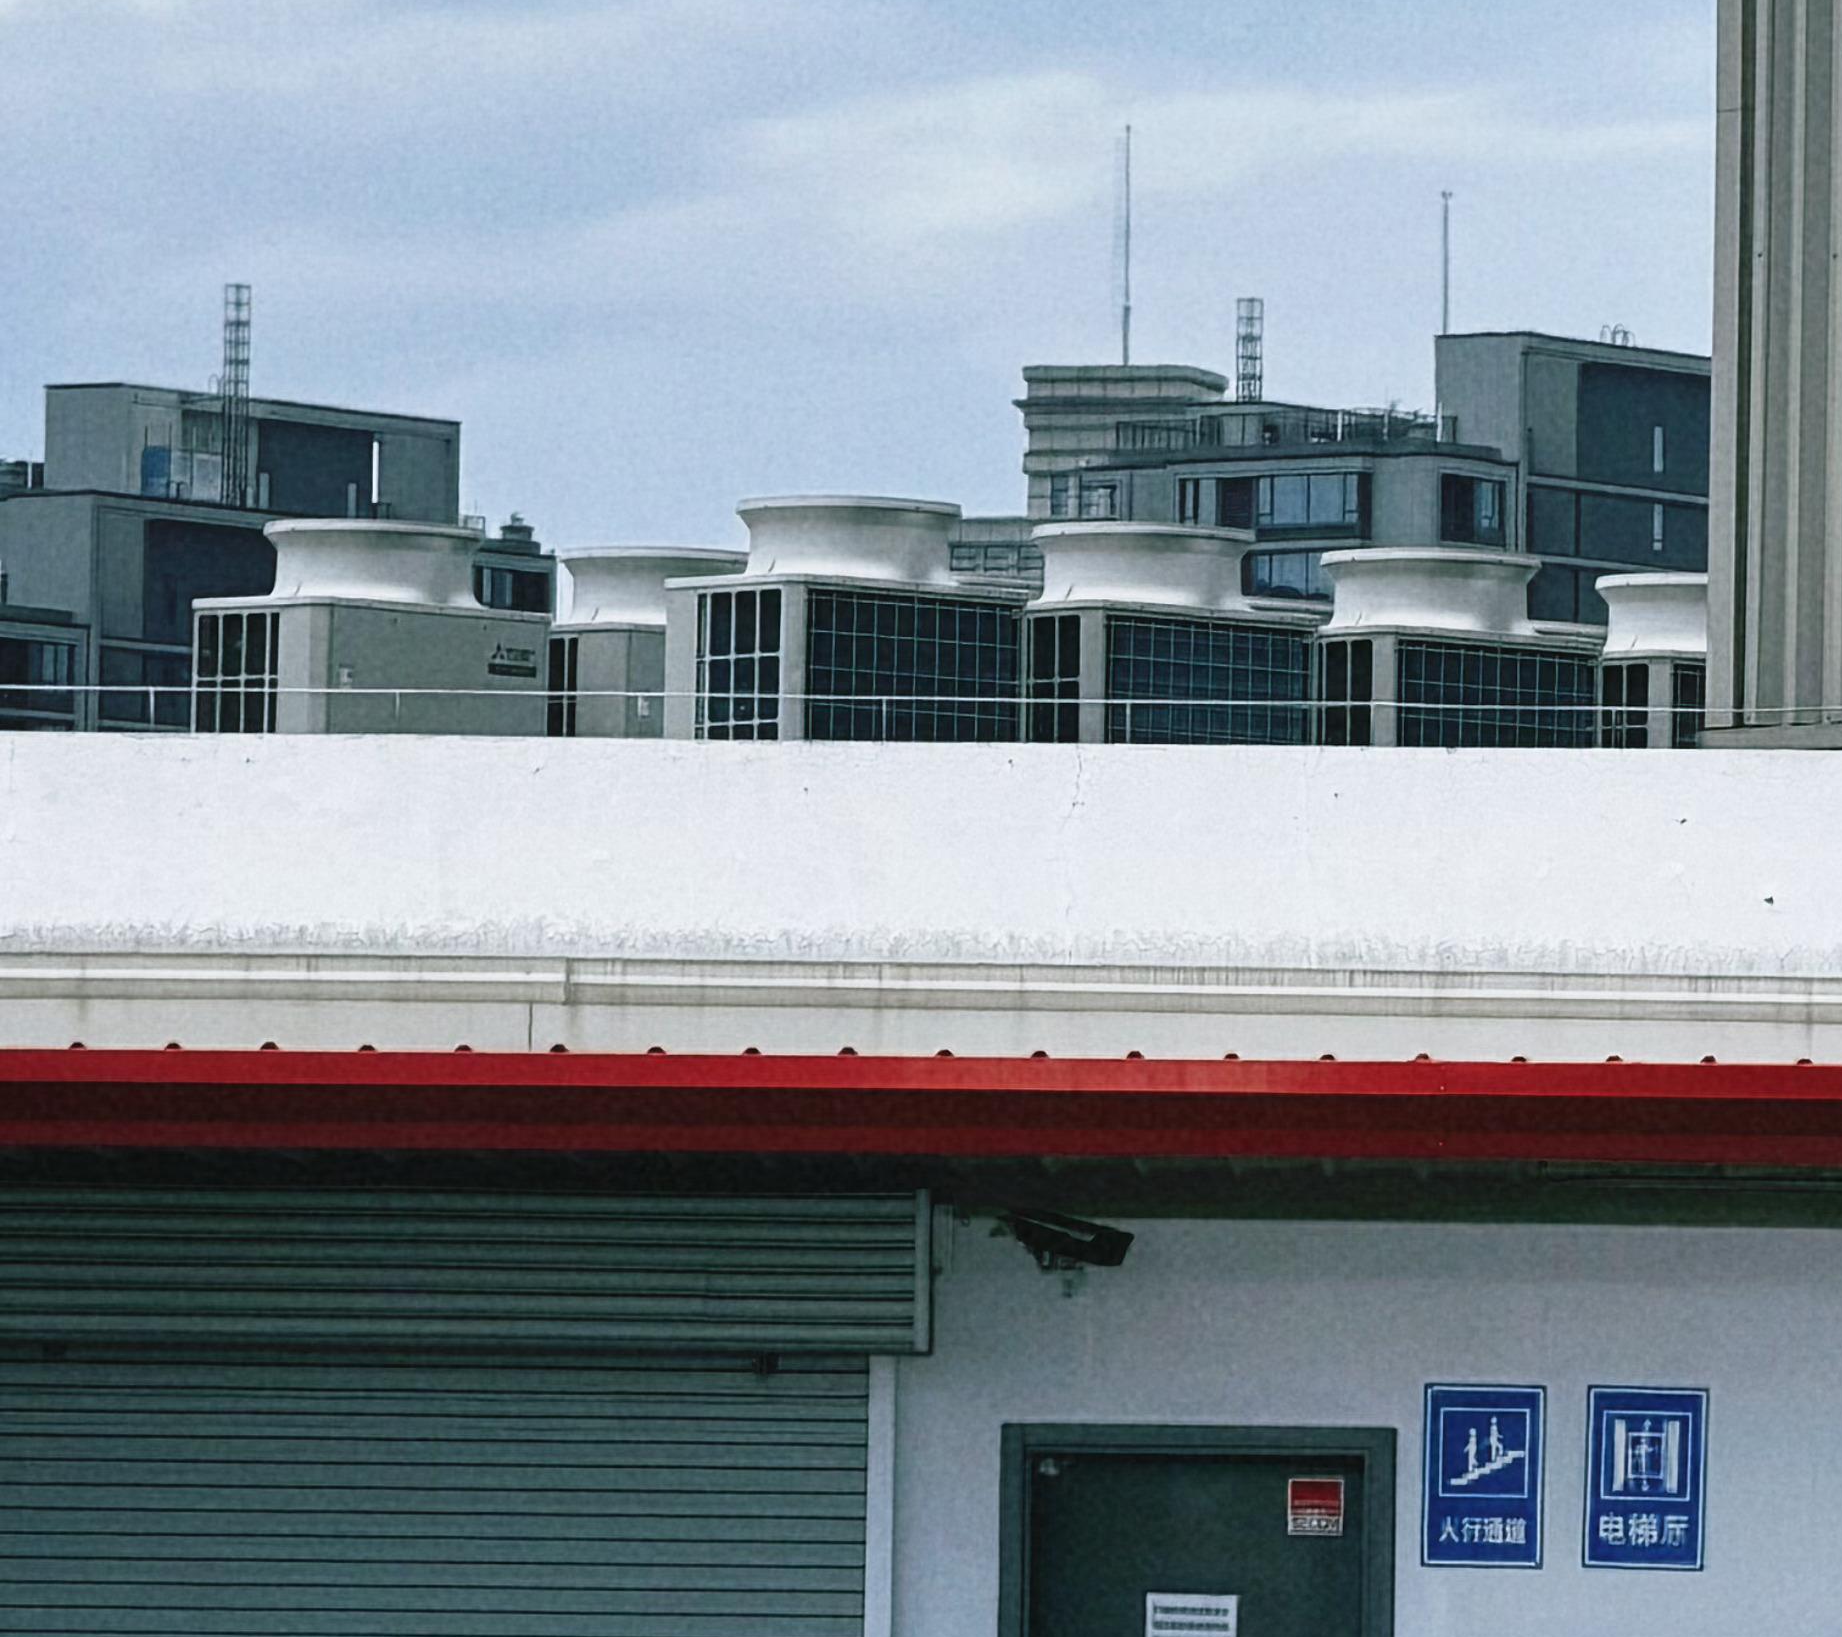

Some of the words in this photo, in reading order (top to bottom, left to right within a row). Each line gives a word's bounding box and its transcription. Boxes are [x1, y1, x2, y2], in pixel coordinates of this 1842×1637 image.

[1439, 1515, 1527, 1544] 人行通道
[1599, 1512, 1689, 1547] 电梯厅
